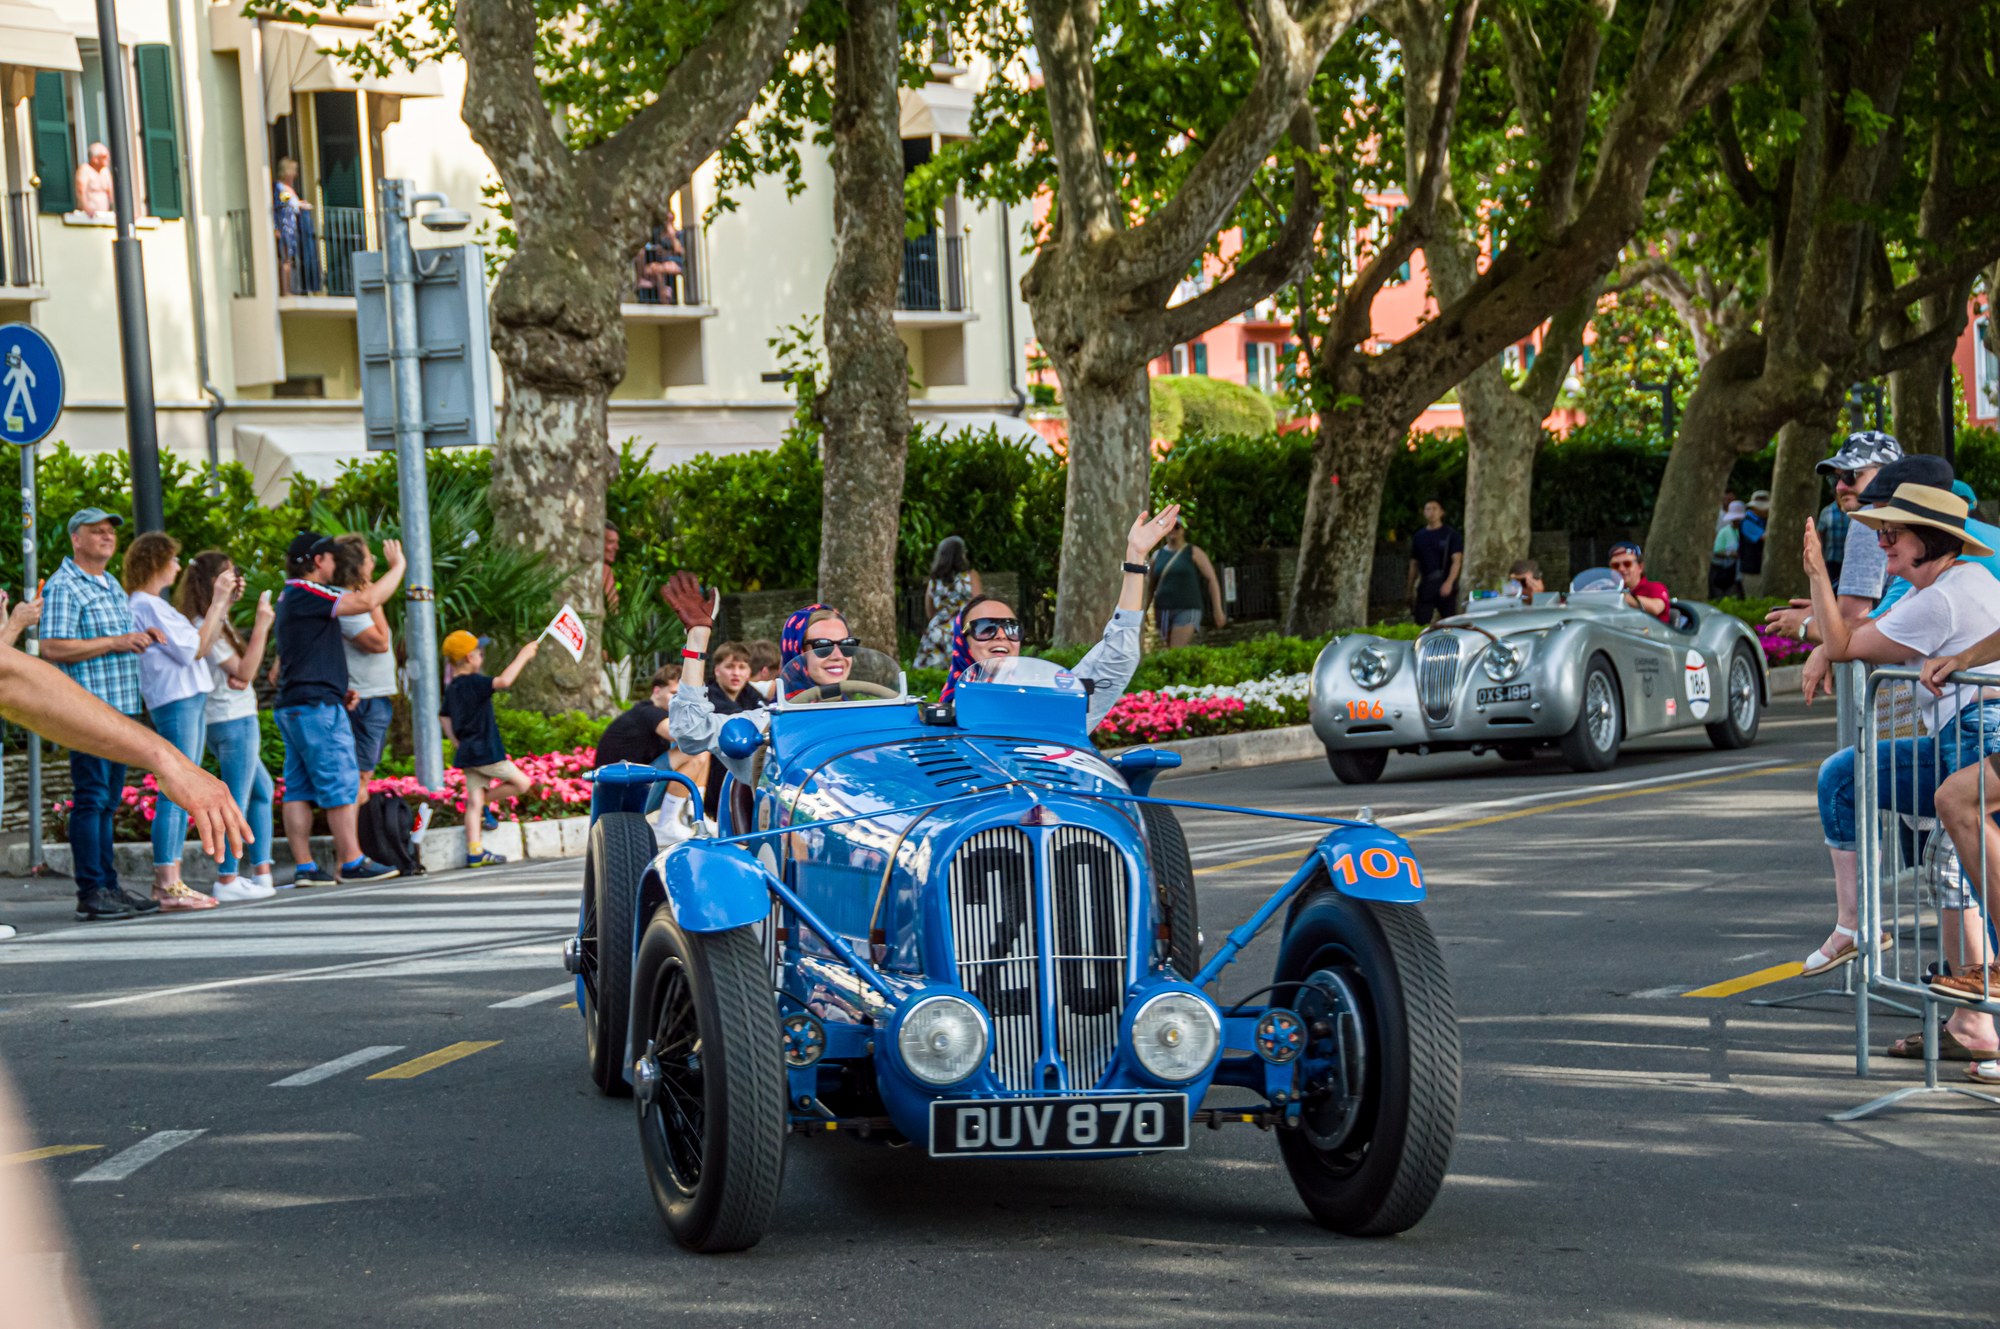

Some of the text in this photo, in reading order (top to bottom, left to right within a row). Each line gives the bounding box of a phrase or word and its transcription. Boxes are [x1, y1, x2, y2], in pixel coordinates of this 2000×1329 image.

[1690, 673, 1706, 694] 186
[1478, 687, 1503, 704] OXS
[1345, 699, 1385, 720] 186
[1332, 847, 1422, 889] 101
[956, 1102, 1165, 1148] DUV 870
